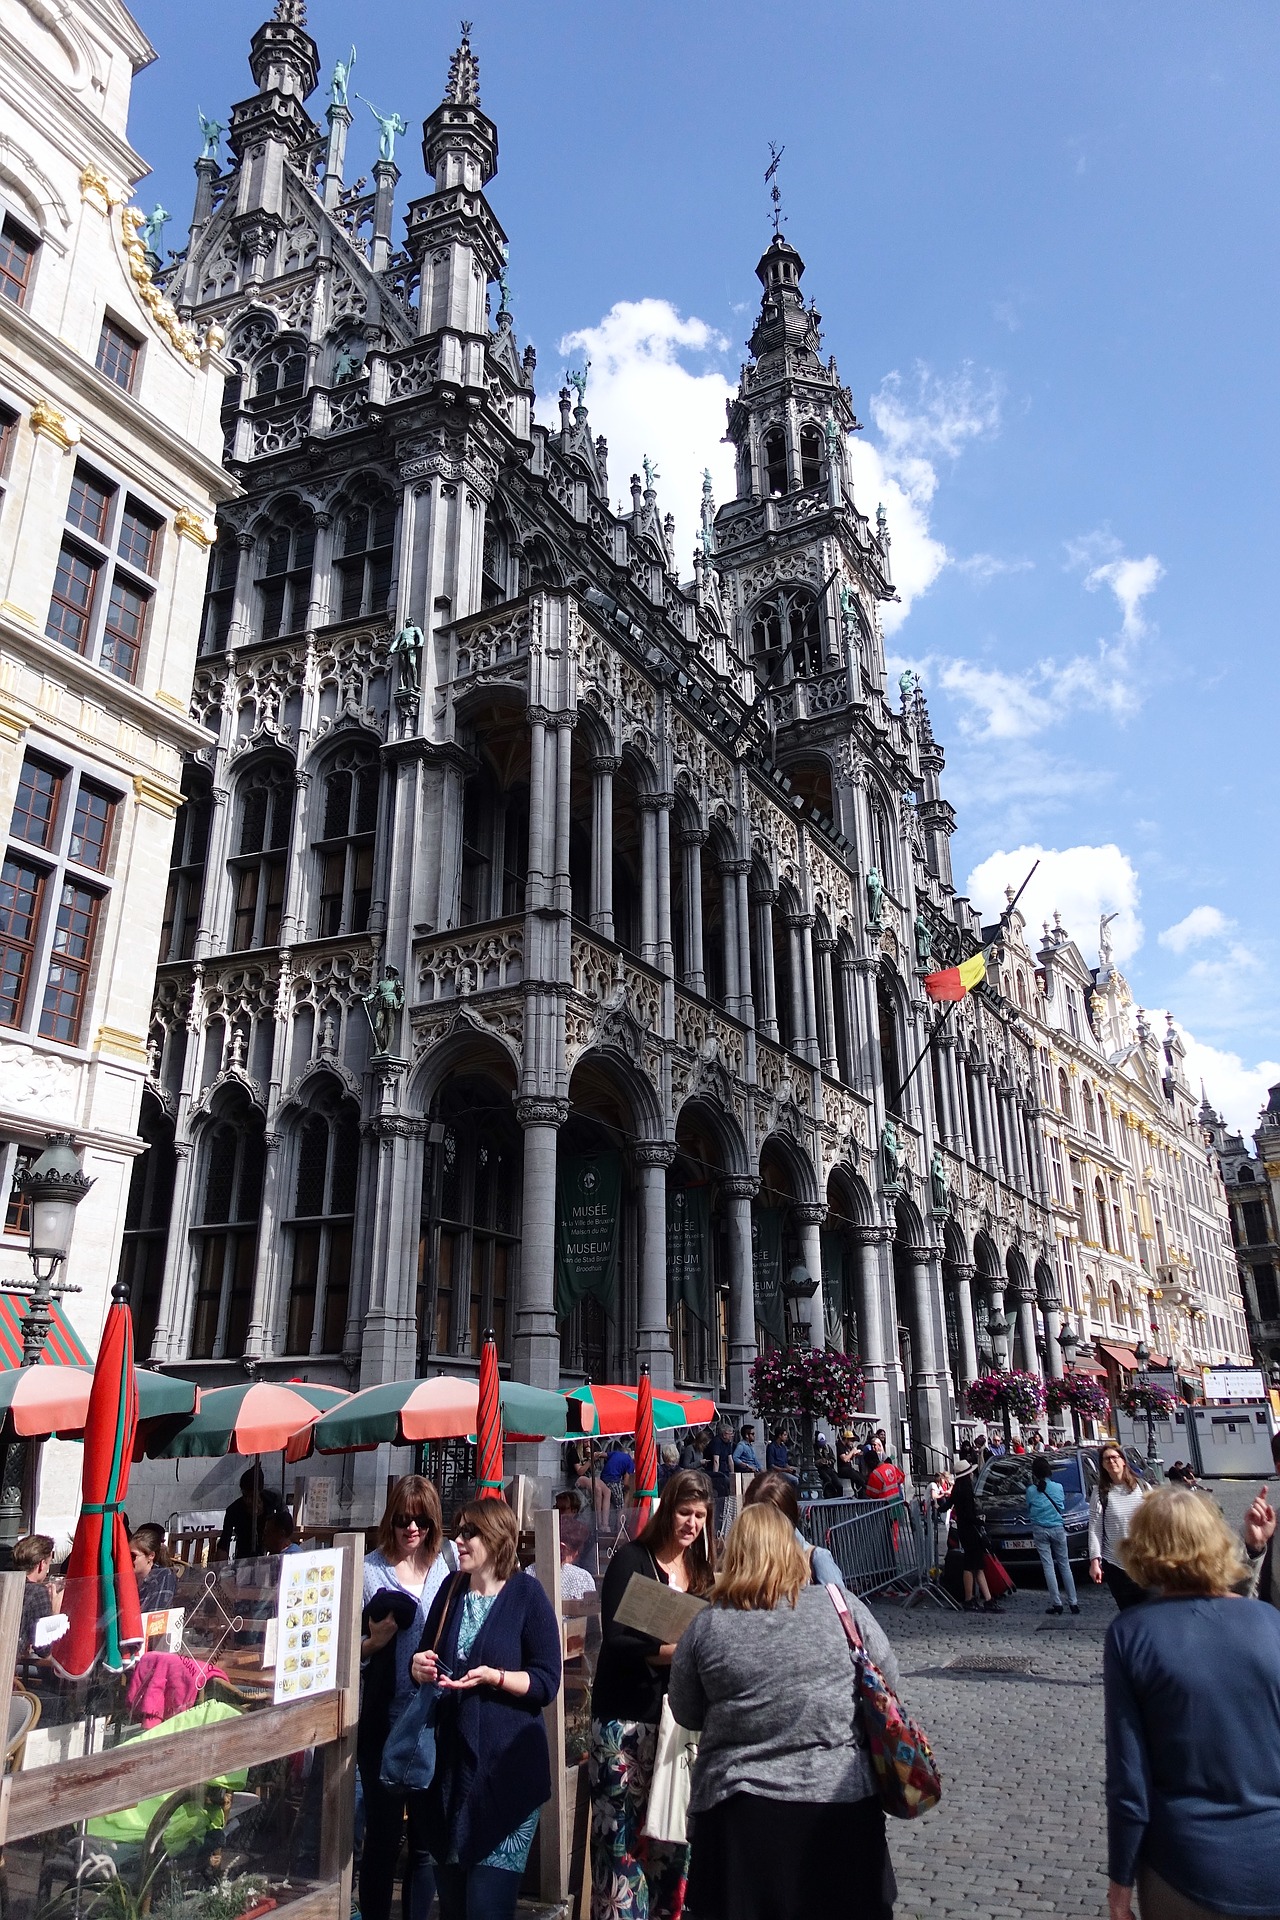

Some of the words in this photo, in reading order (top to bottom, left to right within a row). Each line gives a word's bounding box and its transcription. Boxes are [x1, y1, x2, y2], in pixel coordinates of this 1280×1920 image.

[572, 1203, 608, 1217] MUSÉE
[586, 1218, 594, 1226] de
[666, 1219, 694, 1232] MUÉE
[566, 1241, 610, 1254] MUSEUM
[576, 1265, 602, 1273] Broodhuis
